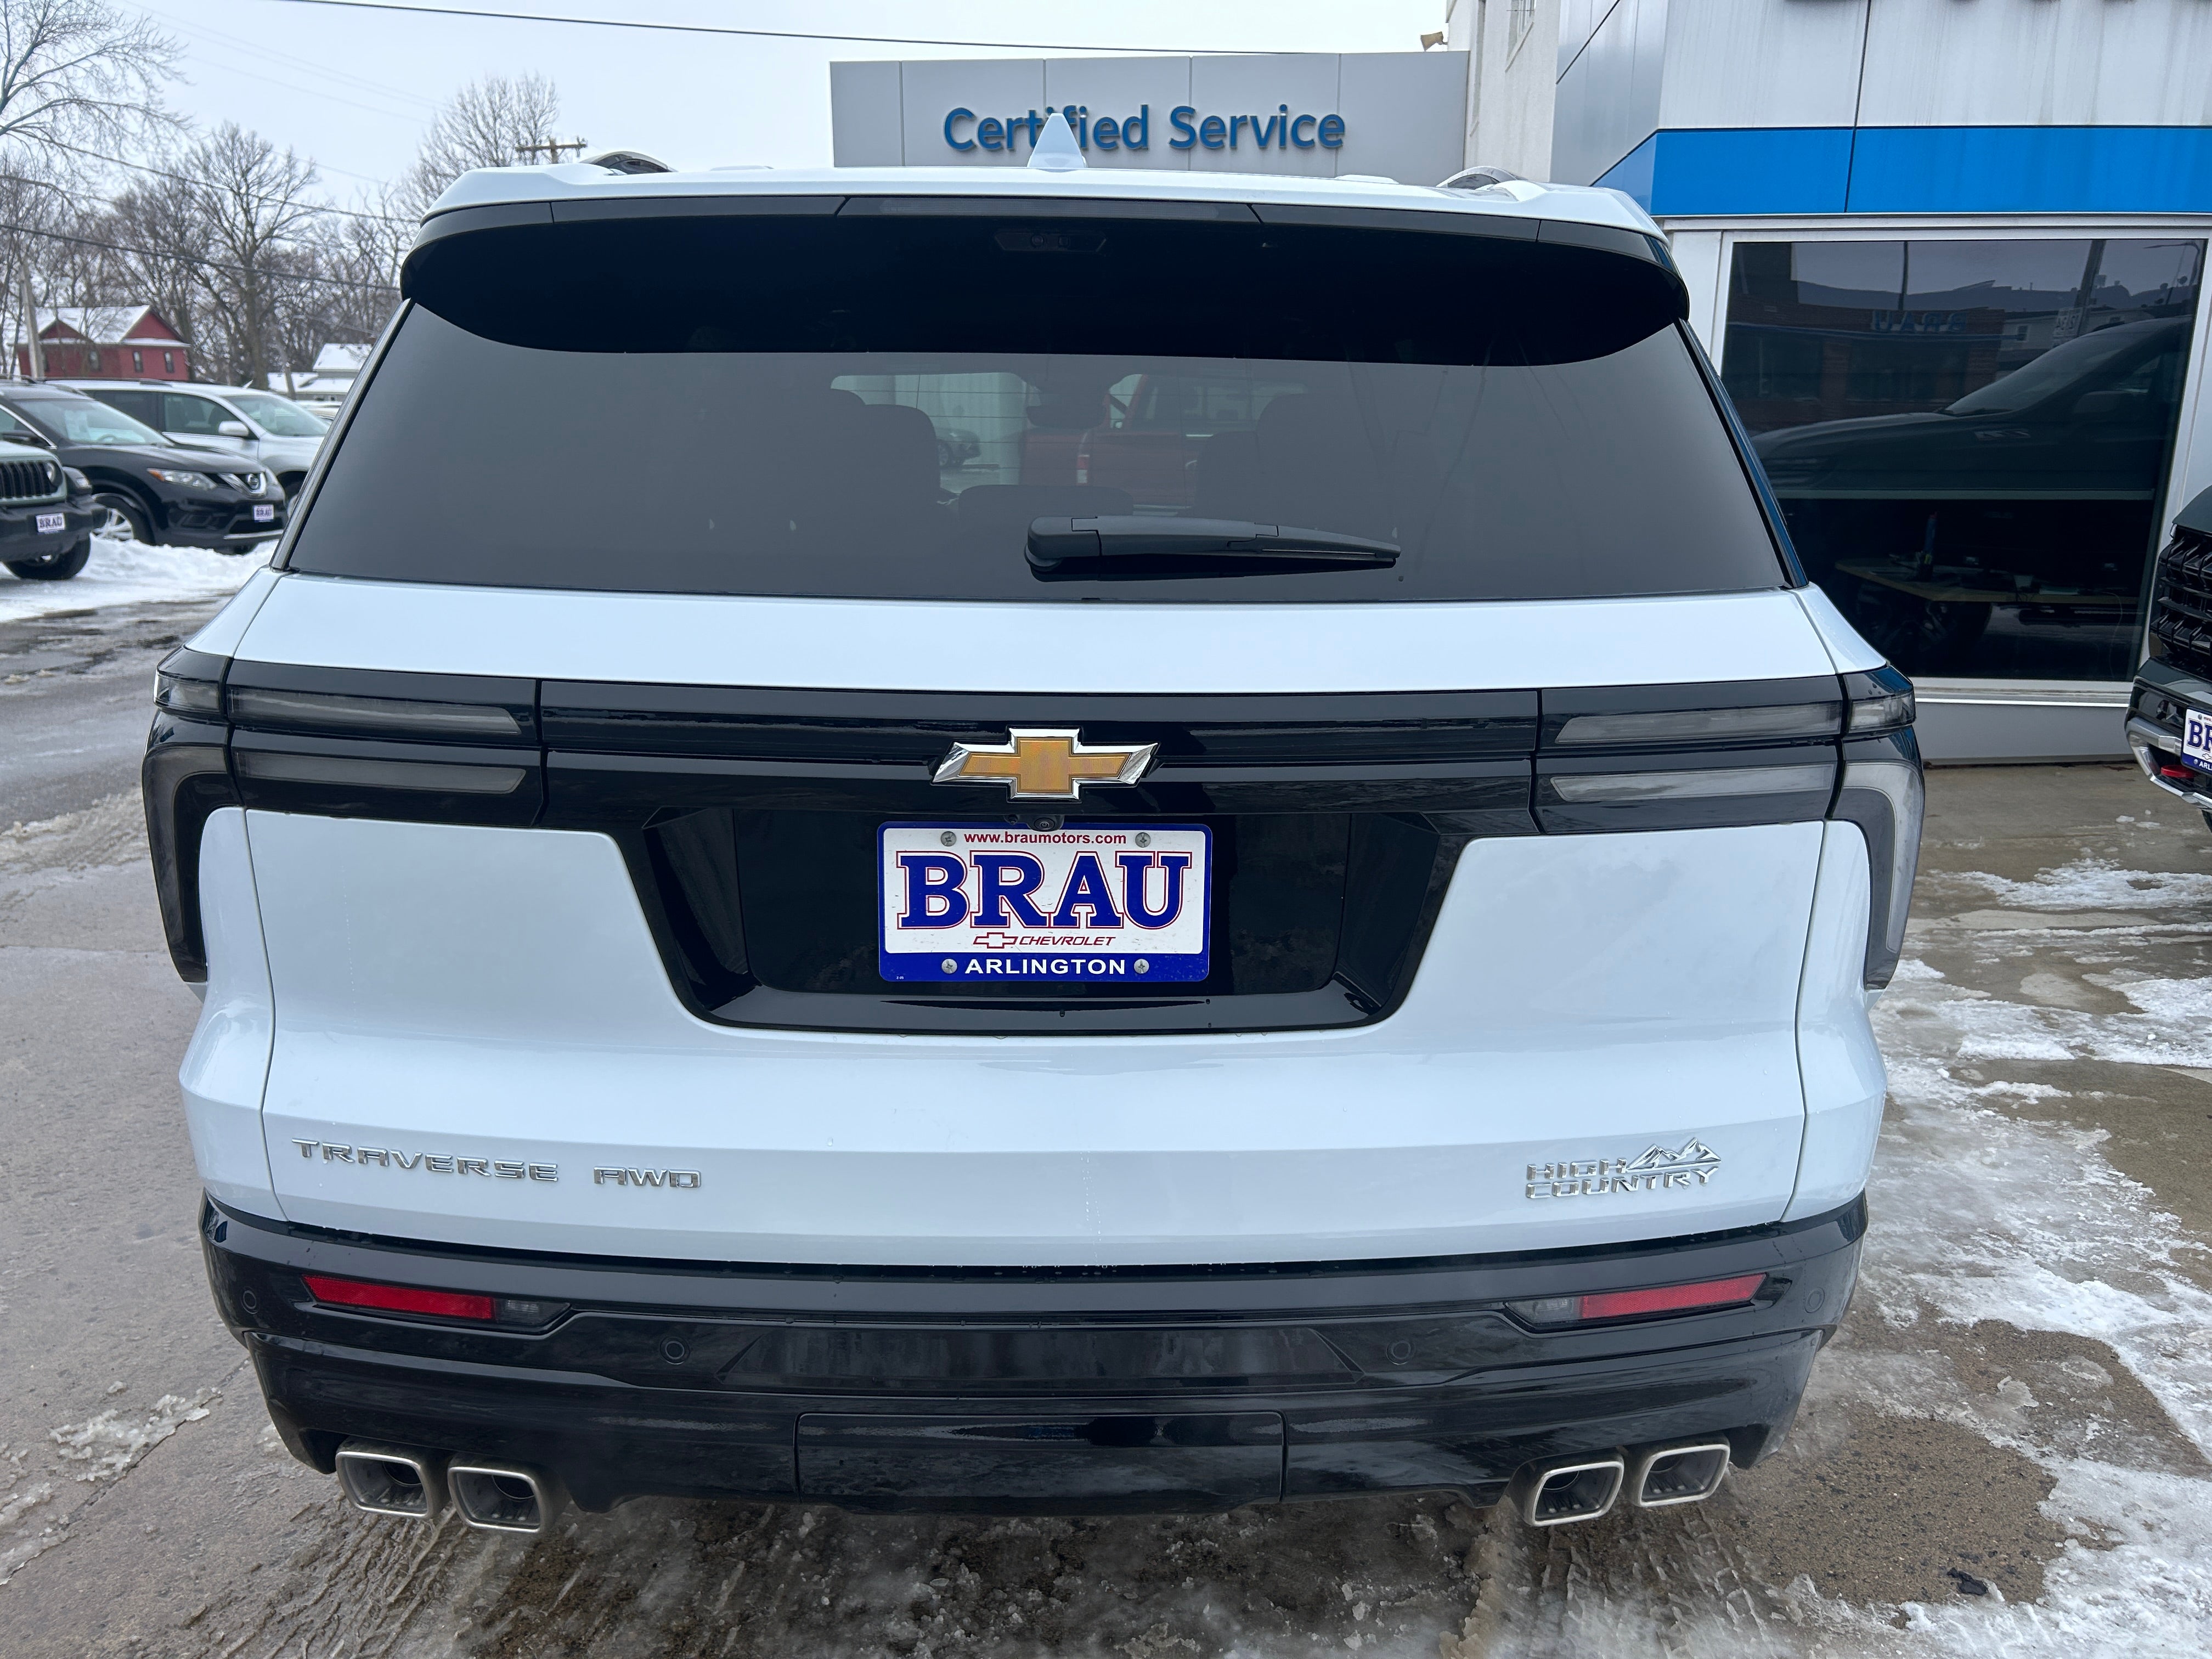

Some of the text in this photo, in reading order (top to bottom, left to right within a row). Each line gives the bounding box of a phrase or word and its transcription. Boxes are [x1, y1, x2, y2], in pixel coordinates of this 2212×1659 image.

[944, 104, 1345, 151] Certfied Service
[964, 831, 1127, 845] www.braumotors.com
[896, 850, 1192, 929] BRAU
[1019, 936, 1116, 946] CHEVROLET
[964, 958, 1125, 975] ARLINGTON
[291, 1138, 702, 1188] TRAVERSE AWD
[1527, 1158, 1627, 1180] HIGH
[1526, 1166, 1719, 1199] COUNTRY
